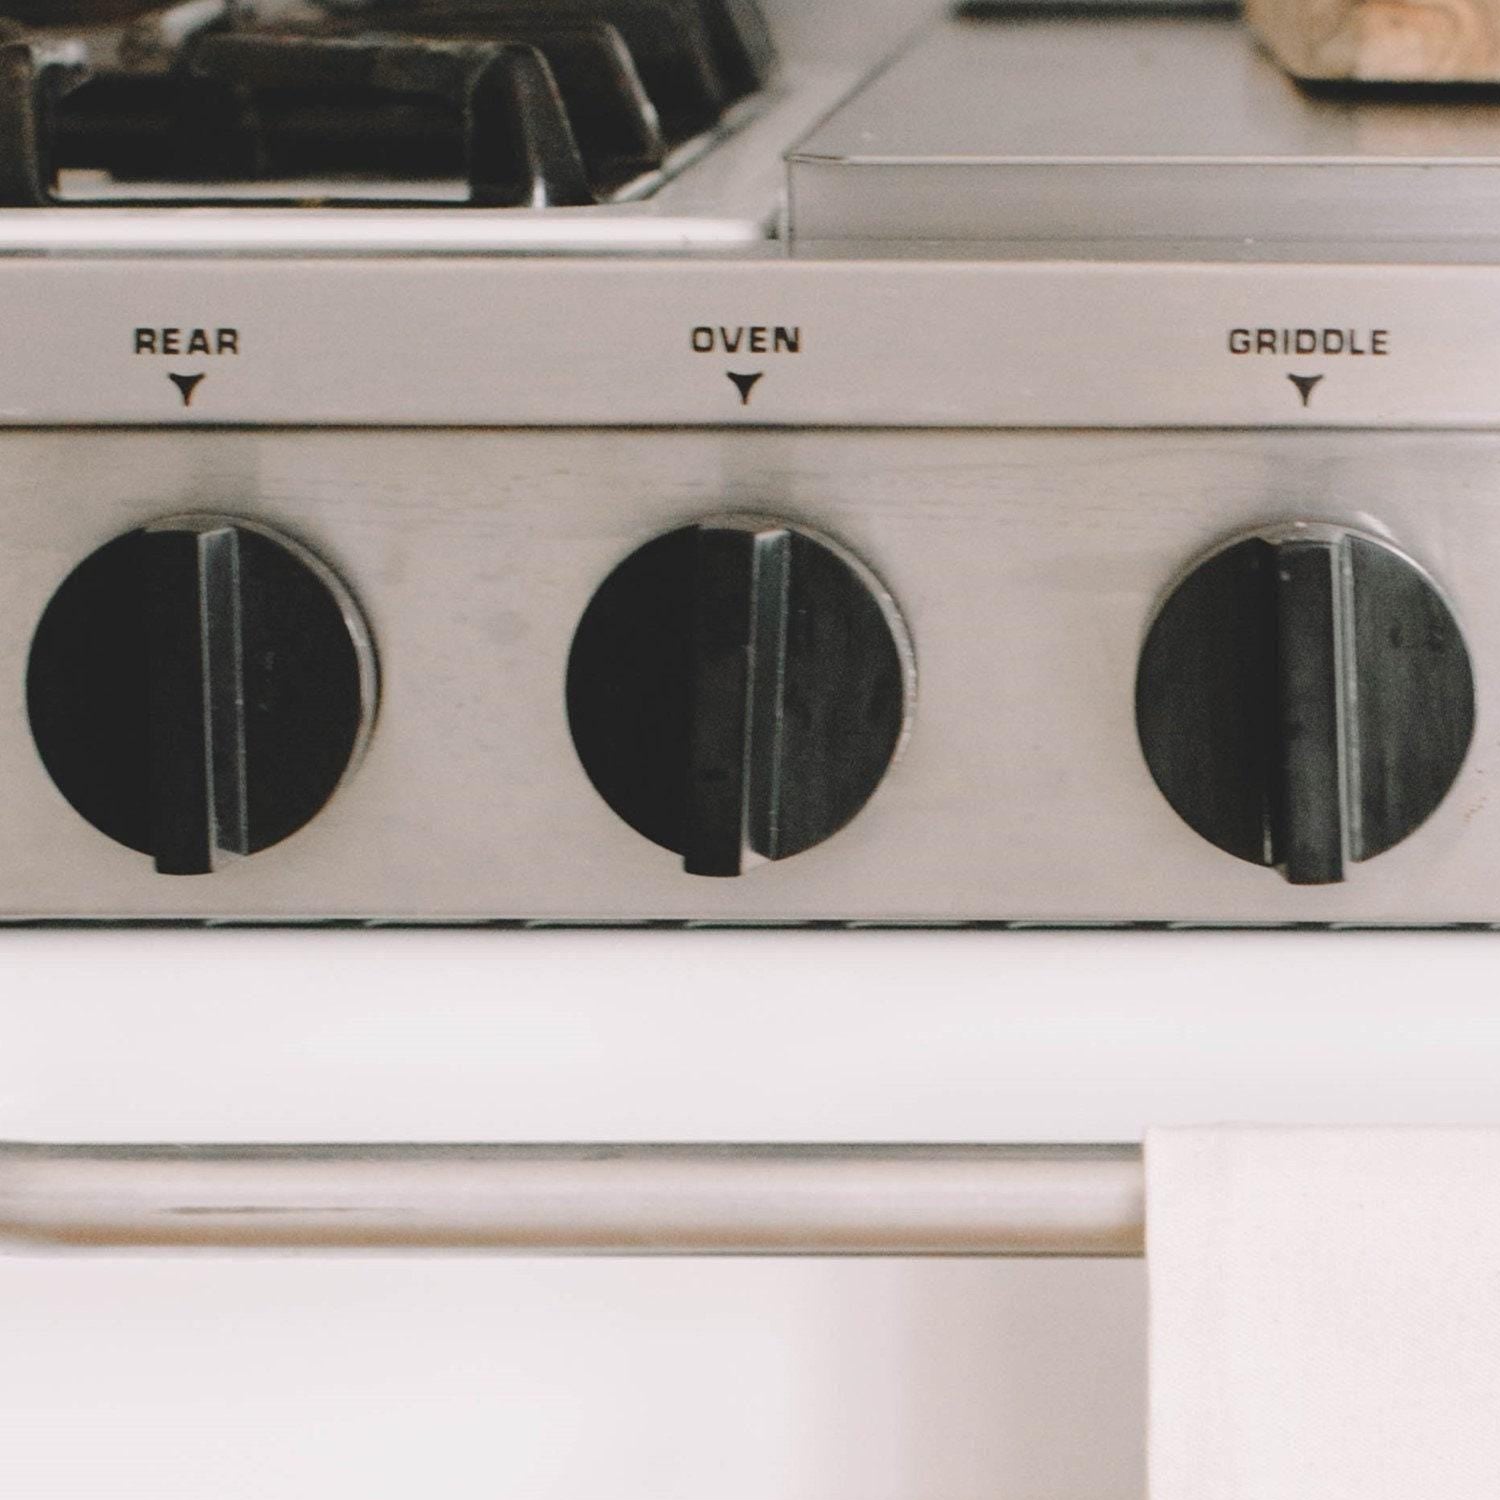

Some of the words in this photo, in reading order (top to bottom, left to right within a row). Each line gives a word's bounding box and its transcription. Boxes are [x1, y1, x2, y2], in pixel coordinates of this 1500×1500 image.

[134, 327, 239, 355] REAR
[690, 326, 800, 353] OVEN
[1228, 328, 1389, 355] GRIDDLE
